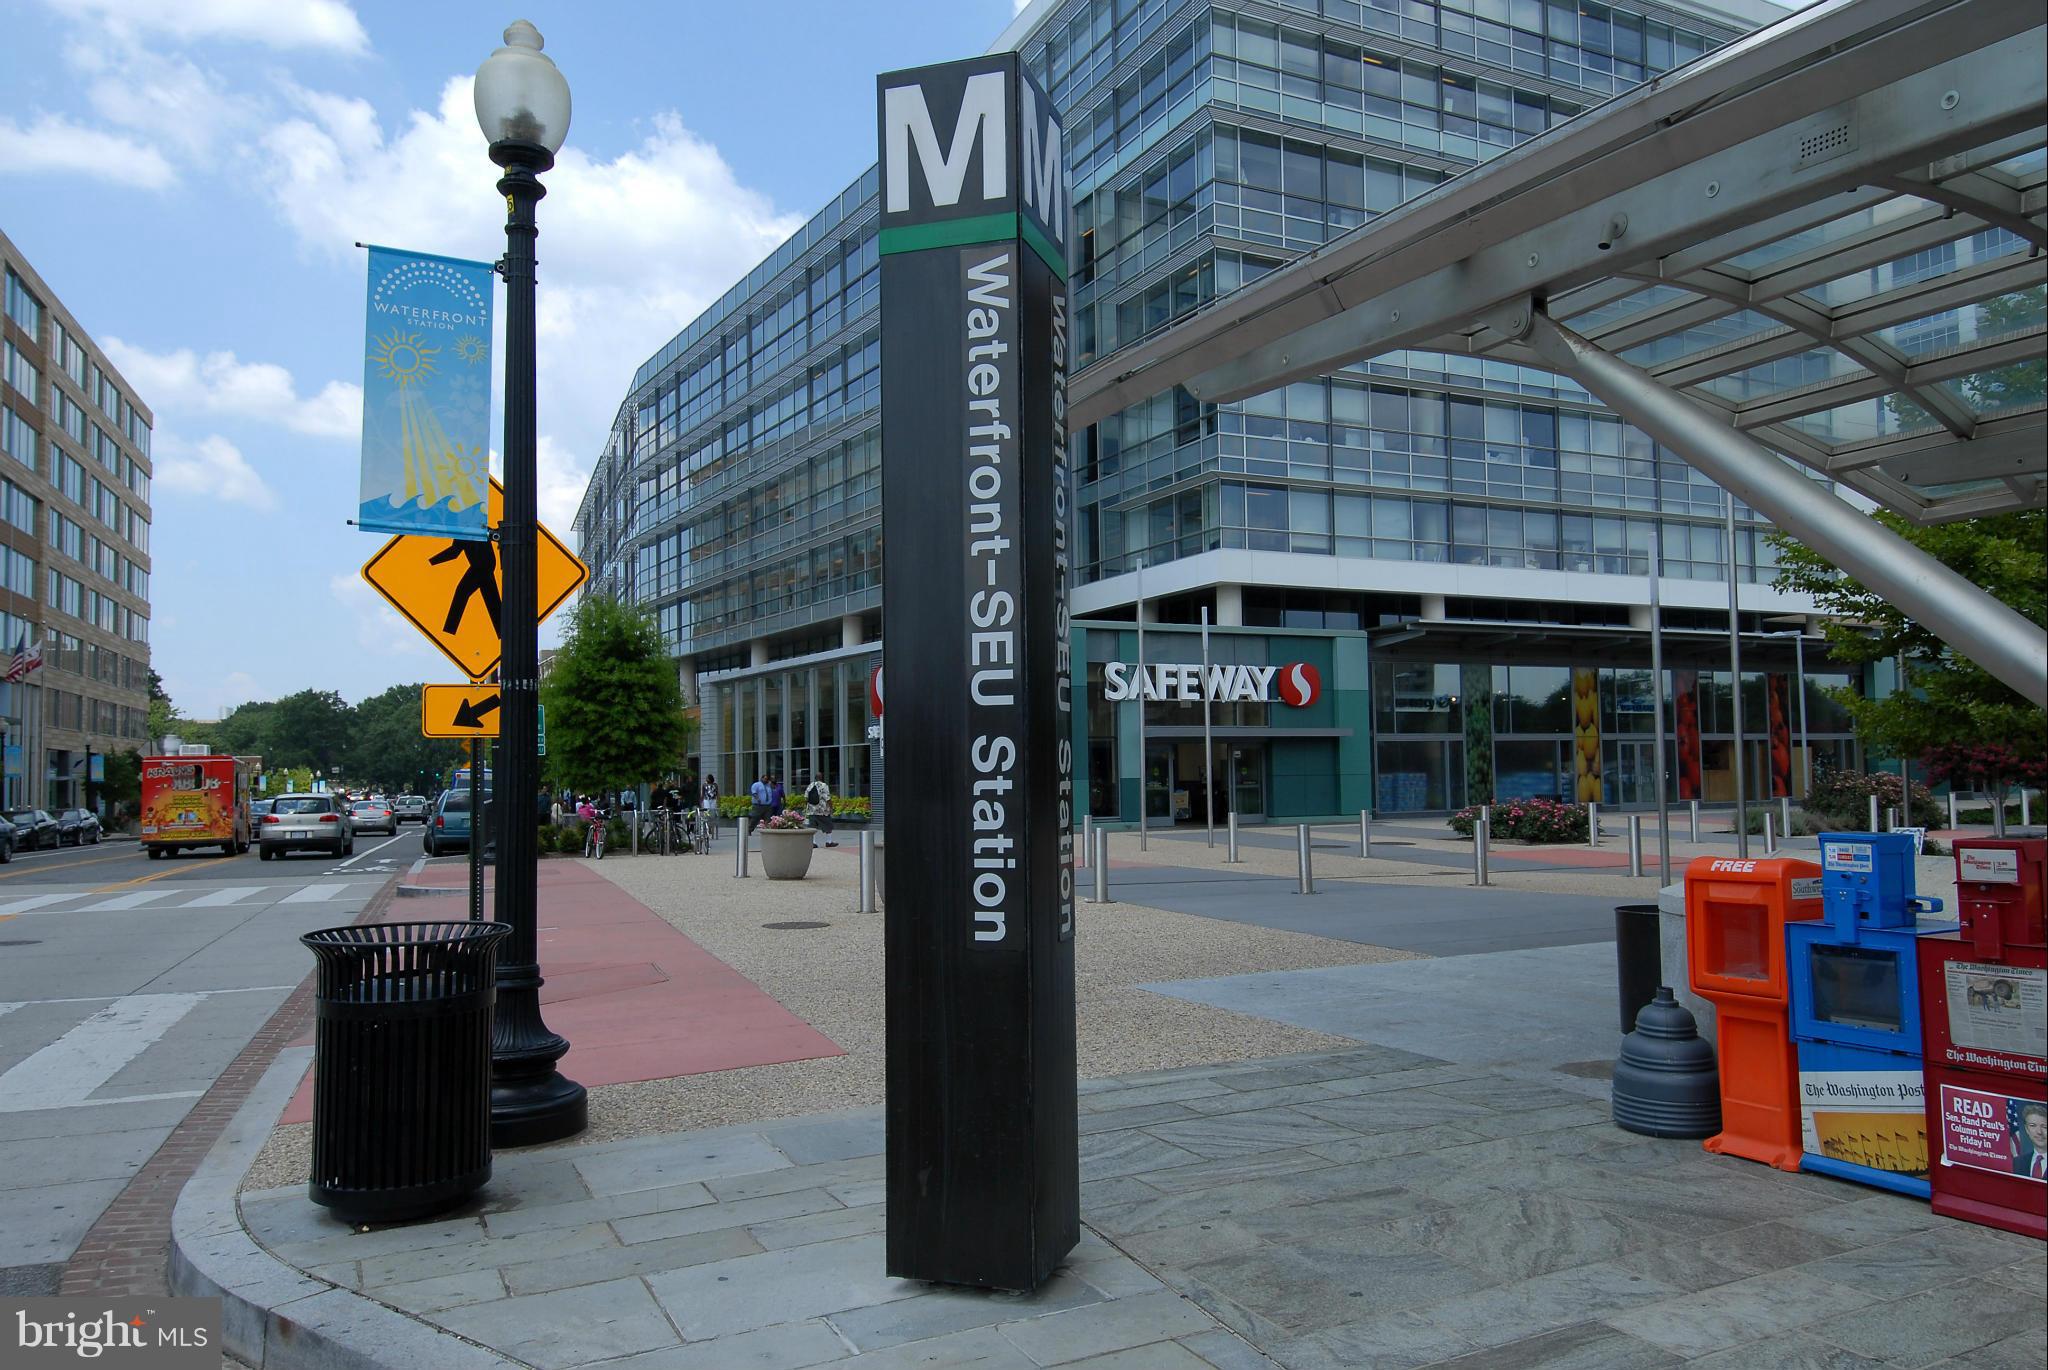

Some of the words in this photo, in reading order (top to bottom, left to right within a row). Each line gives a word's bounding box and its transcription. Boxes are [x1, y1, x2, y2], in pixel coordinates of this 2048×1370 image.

[884, 71, 1007, 213] M
[1022, 75, 1064, 244] M
[374, 302, 487, 327] WATERFRONT
[407, 318, 455, 331] STATION
[1104, 661, 1277, 703] SAFEWAY
[970, 735, 1016, 942] Station
[1058, 738, 1073, 934] Station
[1711, 860, 1757, 873] FREE
[1956, 962, 1969, 970] The
[1969, 963, 2010, 976] Washington
[2010, 967, 2033, 976] Times
[1946, 1049, 1964, 1063] The
[1966, 1051, 2027, 1070] Washington
[2027, 1061, 2047, 1073] Tim
[1805, 1083, 1825, 1098] The
[1826, 1081, 1896, 1100] Washington
[1898, 1083, 1925, 1101] Post
[1953, 1096, 1994, 1119] READ
[1945, 1111, 1961, 1122] Sen.
[1961, 1115, 1980, 1127] Rand
[1981, 1120, 2005, 1131] Paul's
[1950, 1123, 1978, 1137] Column
[1979, 1129, 2000, 1142] Every
[1960, 1134, 1983, 1149] Friday
[1983, 1139, 1992, 1149] in
[1949, 1143, 1958, 1151] The
[1958, 1145, 1990, 1157] Washington
[1989, 1151, 2007, 1160] Times
